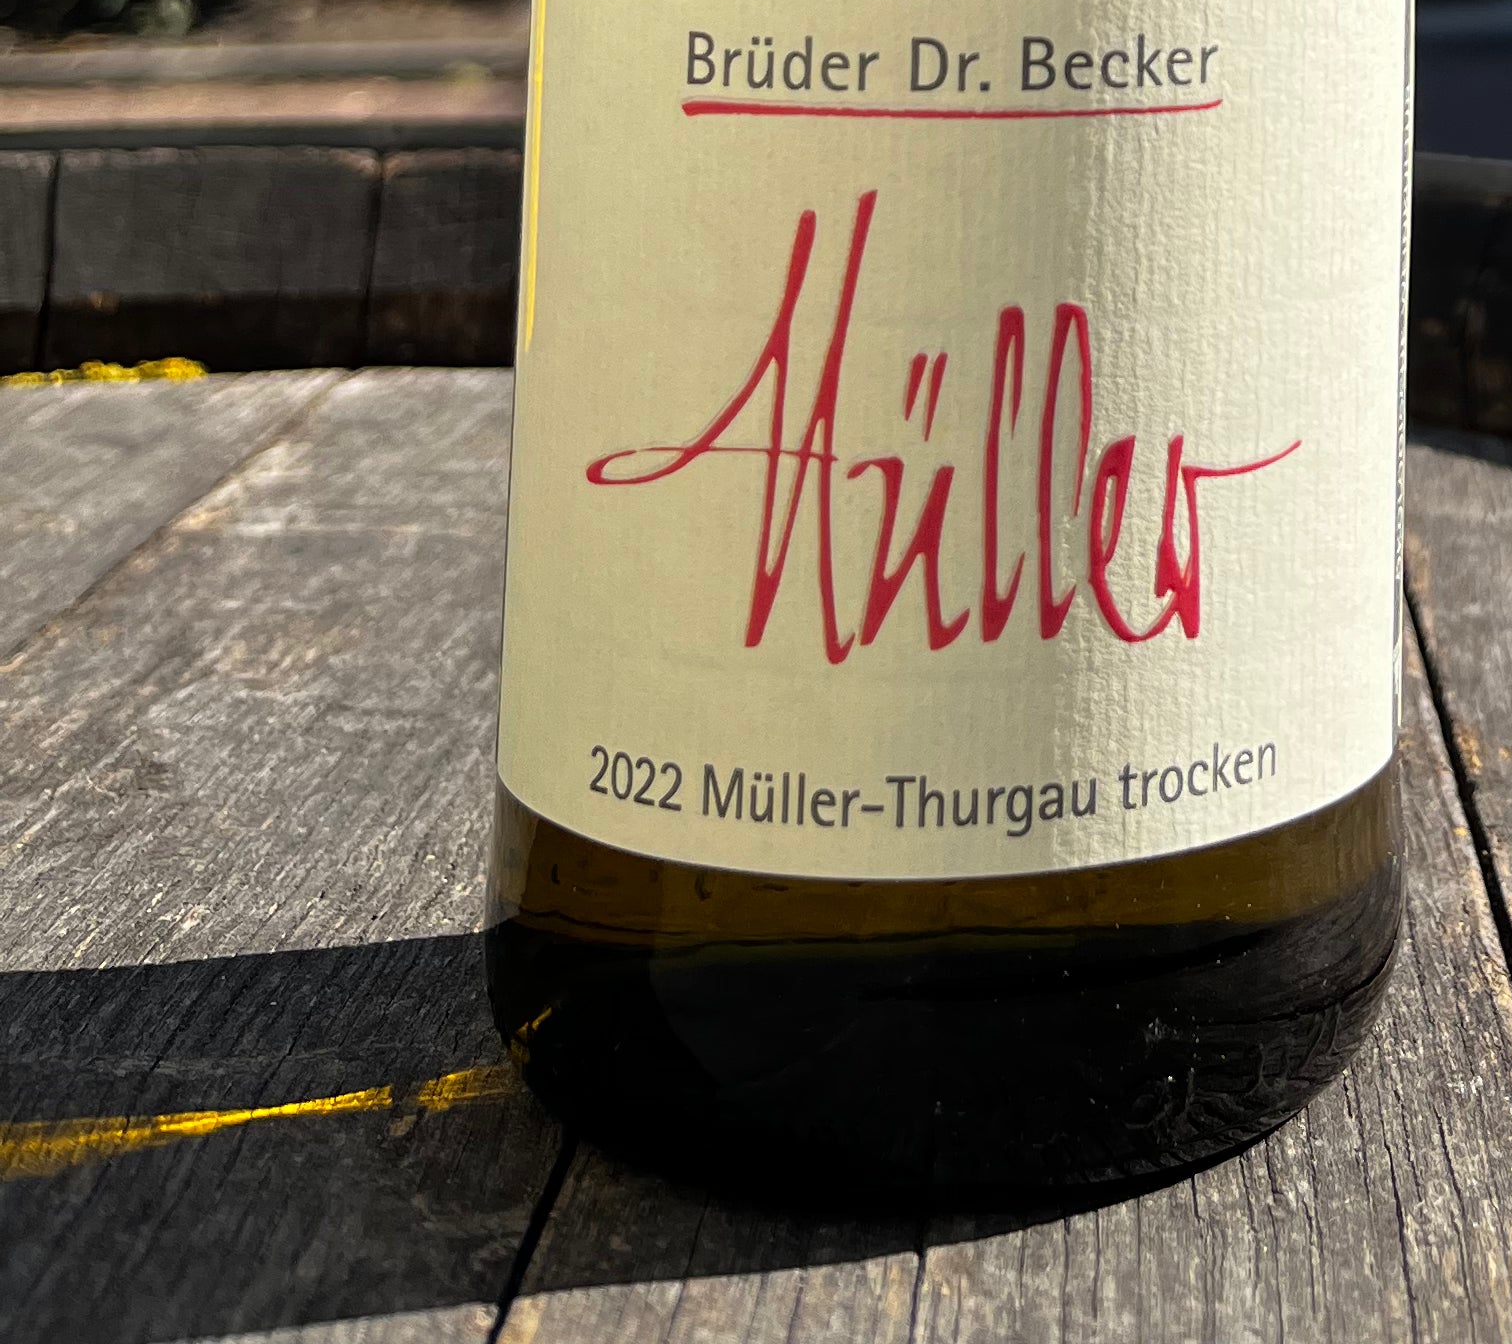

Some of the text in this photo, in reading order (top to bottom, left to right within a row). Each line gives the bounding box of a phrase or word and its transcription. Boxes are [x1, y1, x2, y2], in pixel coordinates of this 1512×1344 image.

[687, 31, 1217, 92] Brüder Dr. Becker
[589, 739, 1278, 838] 2022 Müller-Thurgau trocken
